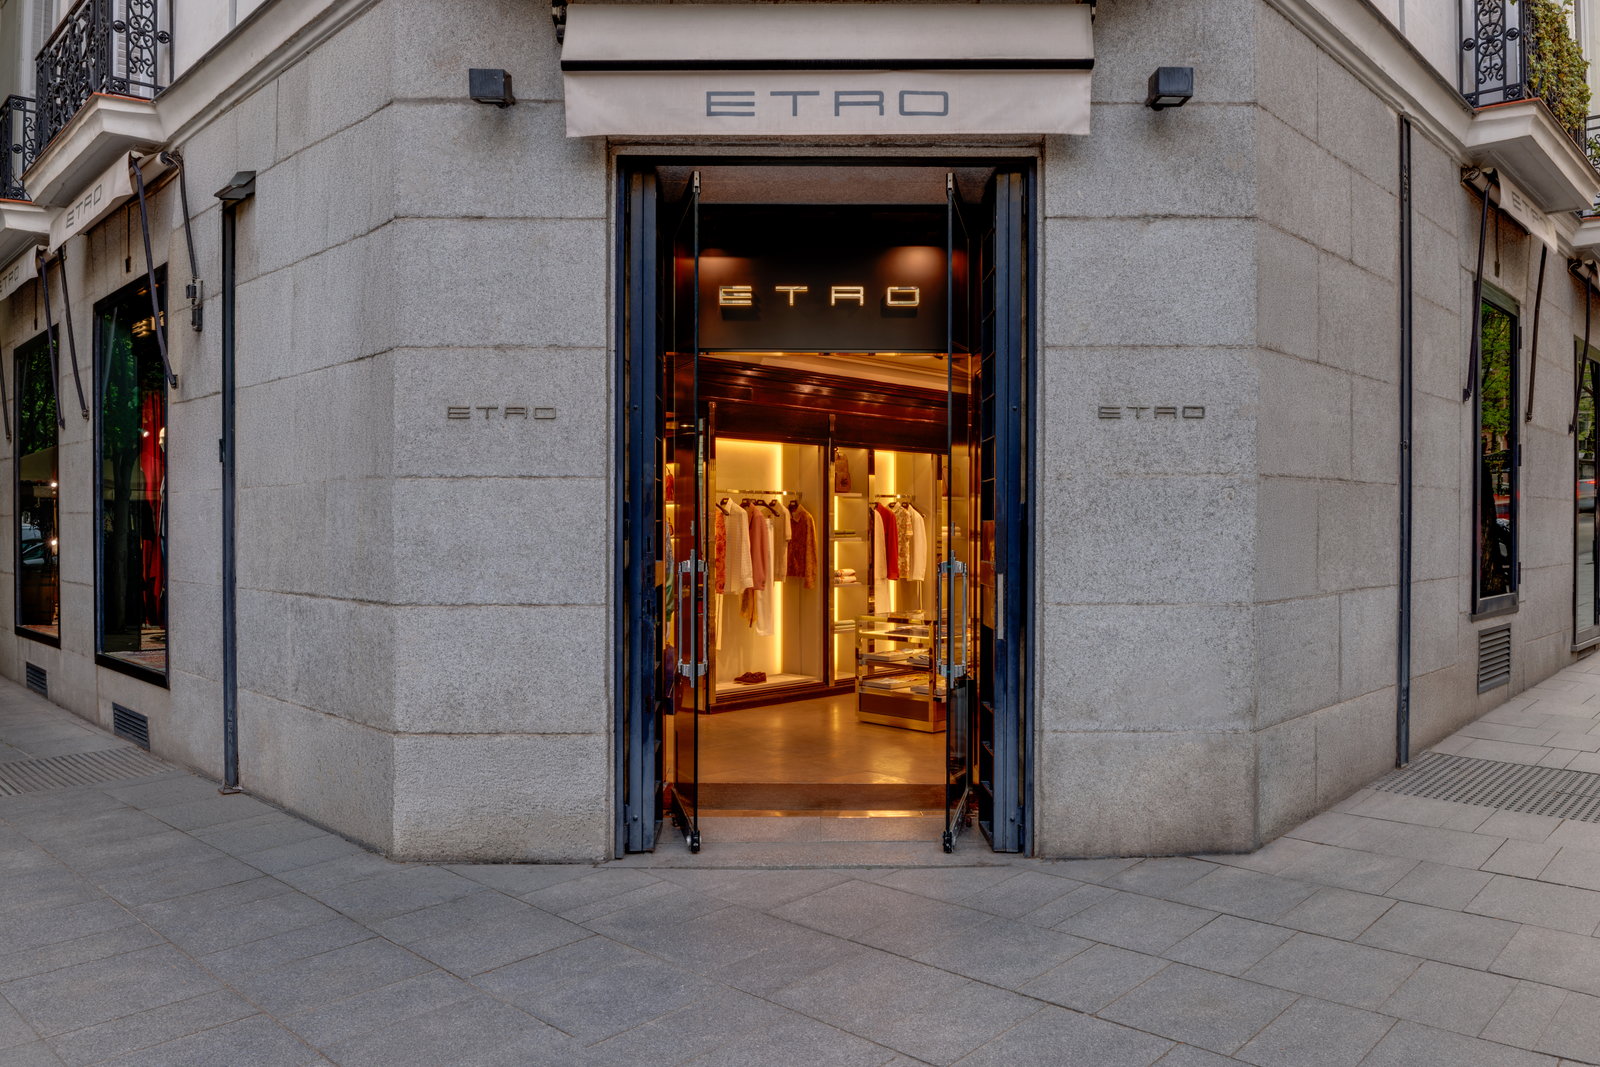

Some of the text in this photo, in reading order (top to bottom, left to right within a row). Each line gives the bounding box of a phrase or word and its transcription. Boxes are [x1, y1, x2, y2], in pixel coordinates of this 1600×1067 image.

[706, 91, 949, 117] ETRO
[66, 184, 102, 228] ETRO
[719, 285, 920, 307] ETRO
[448, 407, 557, 420] ETRO
[1098, 406, 1205, 419] ETRO
